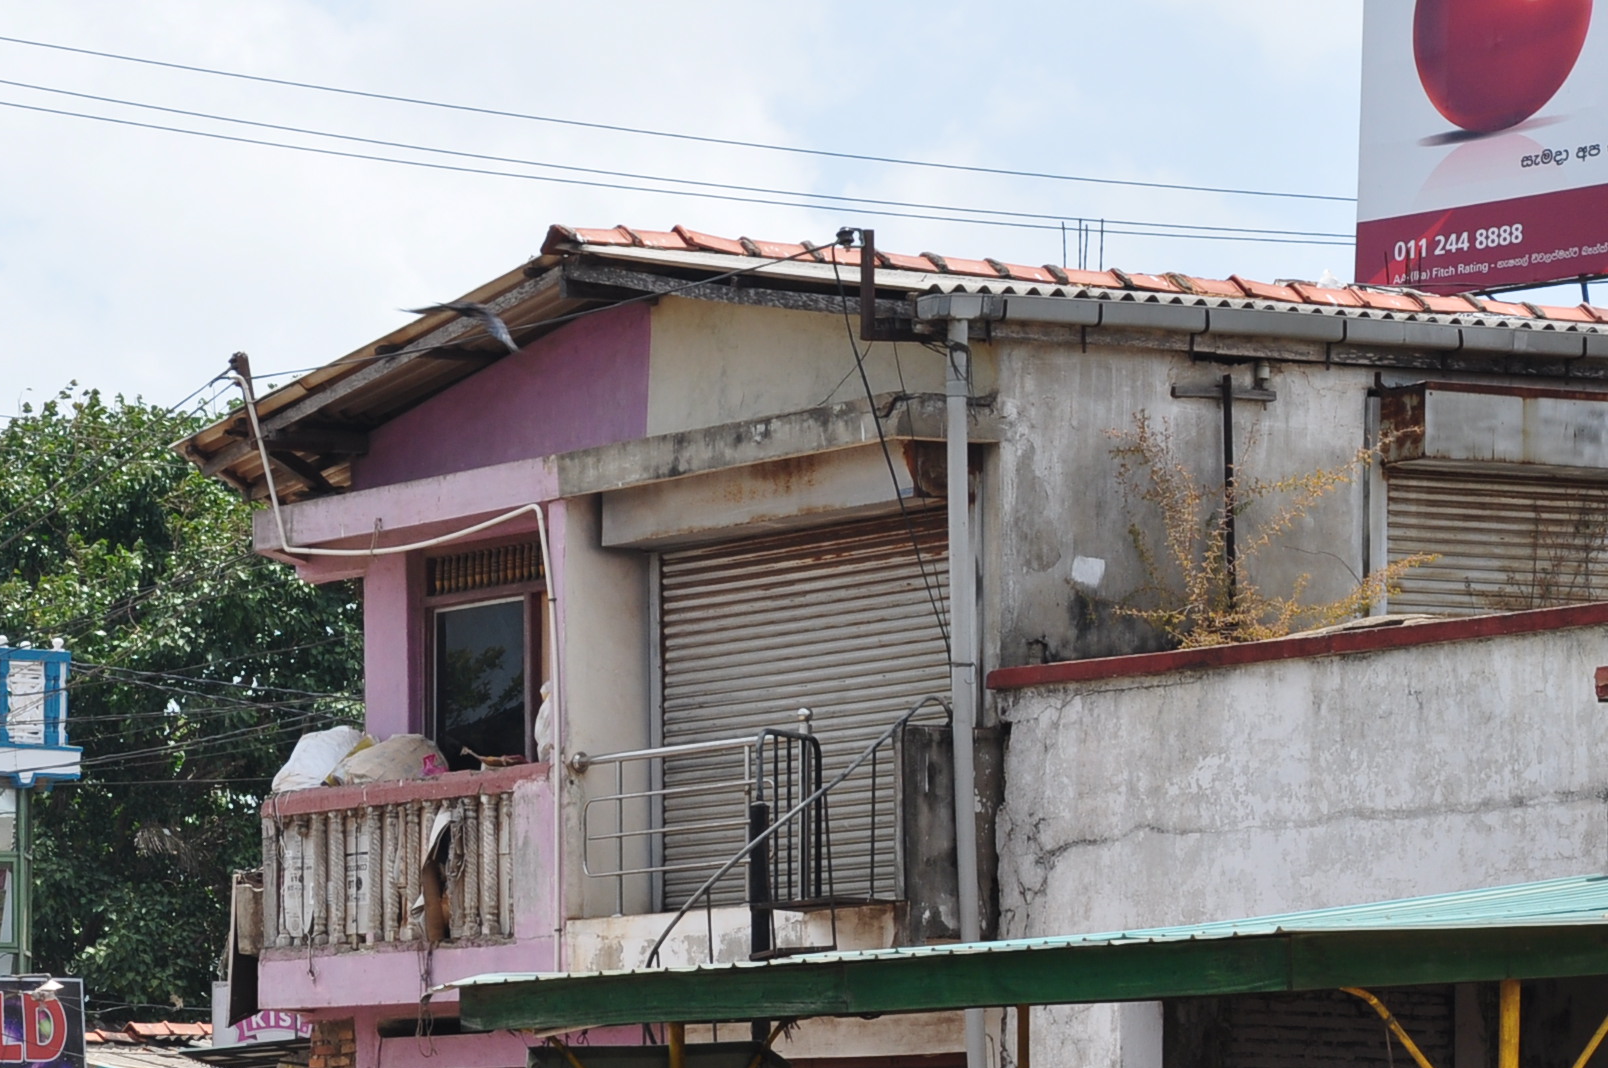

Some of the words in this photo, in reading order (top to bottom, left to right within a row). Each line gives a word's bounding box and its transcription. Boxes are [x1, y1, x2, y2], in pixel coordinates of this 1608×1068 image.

[1576, 144, 1600, 161] අප
[1394, 237, 1426, 261] 011
[1434, 231, 1470, 256] 244
[1475, 224, 1522, 249] 8888
[1432, 264, 1455, 278] Fitch
[1458, 260, 1488, 276] Rating
